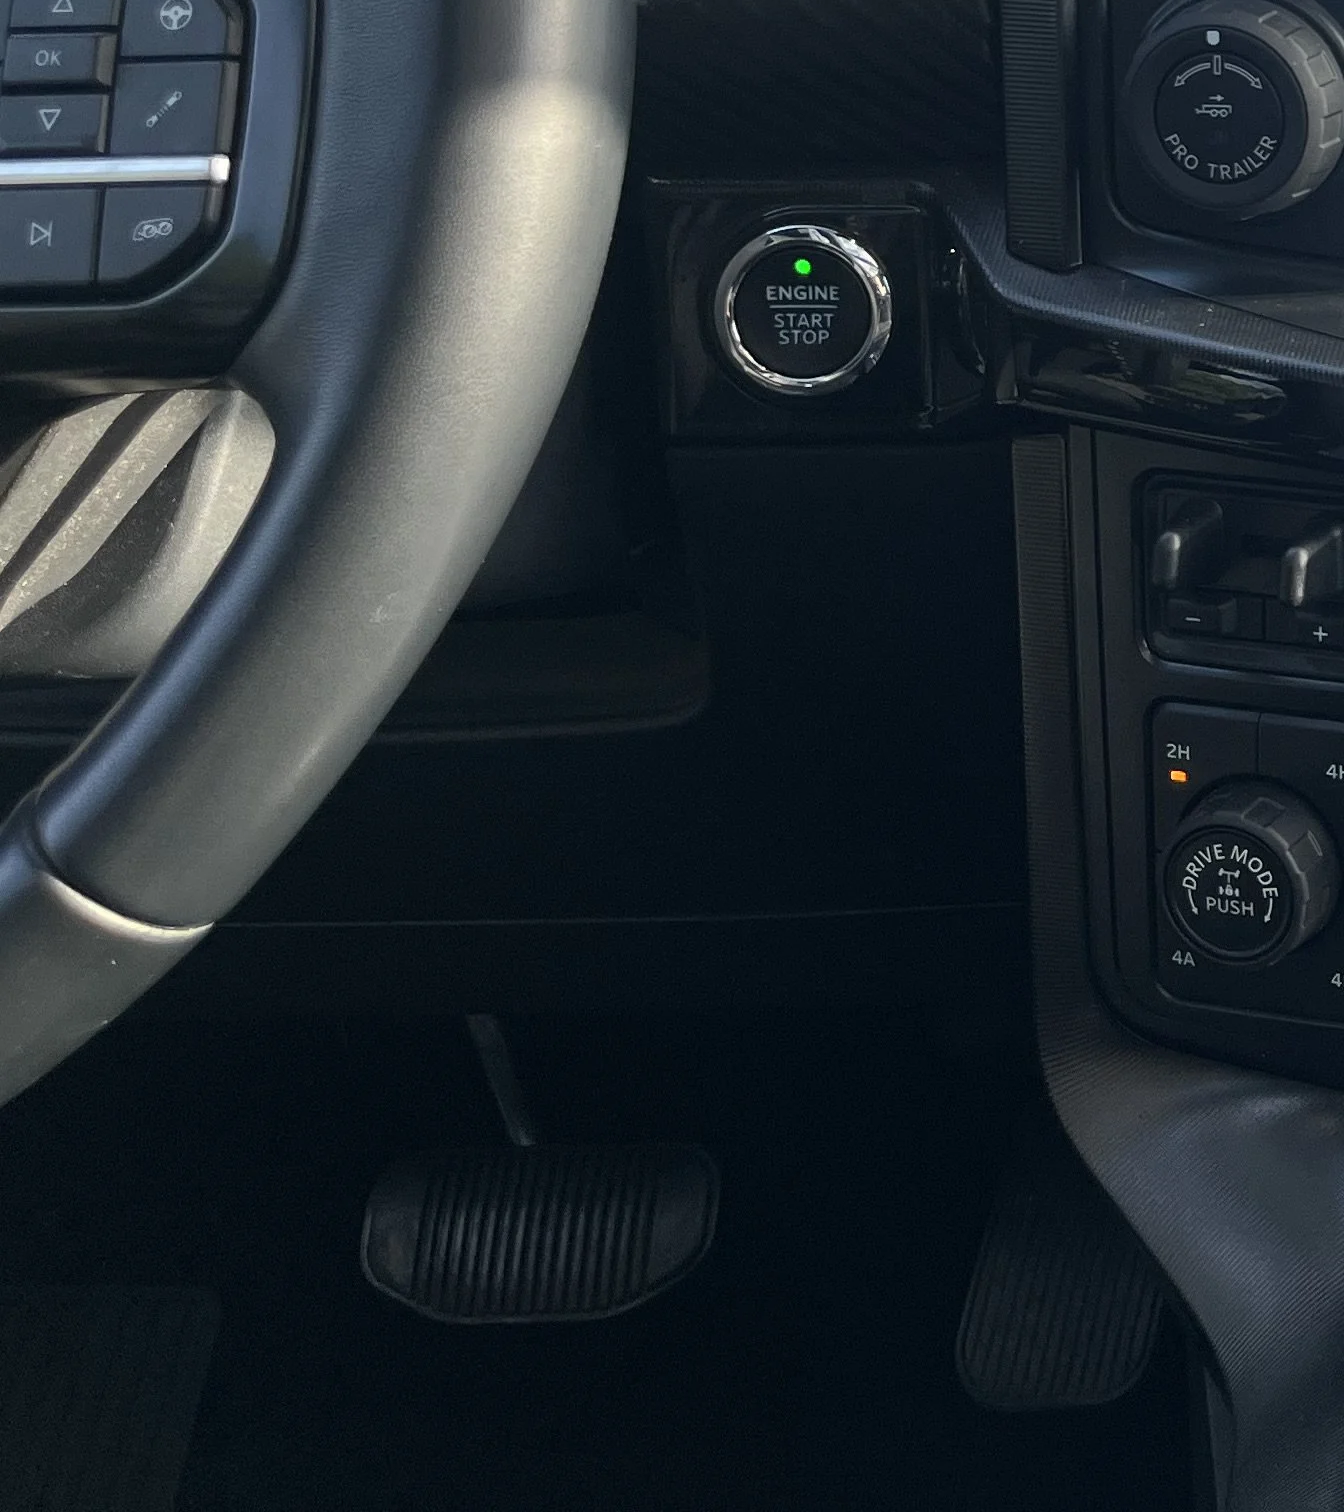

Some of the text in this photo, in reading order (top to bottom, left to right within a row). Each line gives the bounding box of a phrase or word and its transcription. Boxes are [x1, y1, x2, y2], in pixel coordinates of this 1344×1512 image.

[34, 49, 62, 67] OK
[1164, 132, 1278, 181] PRO TRAILER
[765, 285, 840, 303] ENGINE
[773, 312, 835, 329] START
[778, 329, 831, 347] STOP
[1166, 743, 1191, 762] 2H
[1181, 843, 1279, 899] DRIVE MODE
[1205, 895, 1255, 917] PUSH
[1171, 949, 1196, 967] 4A
